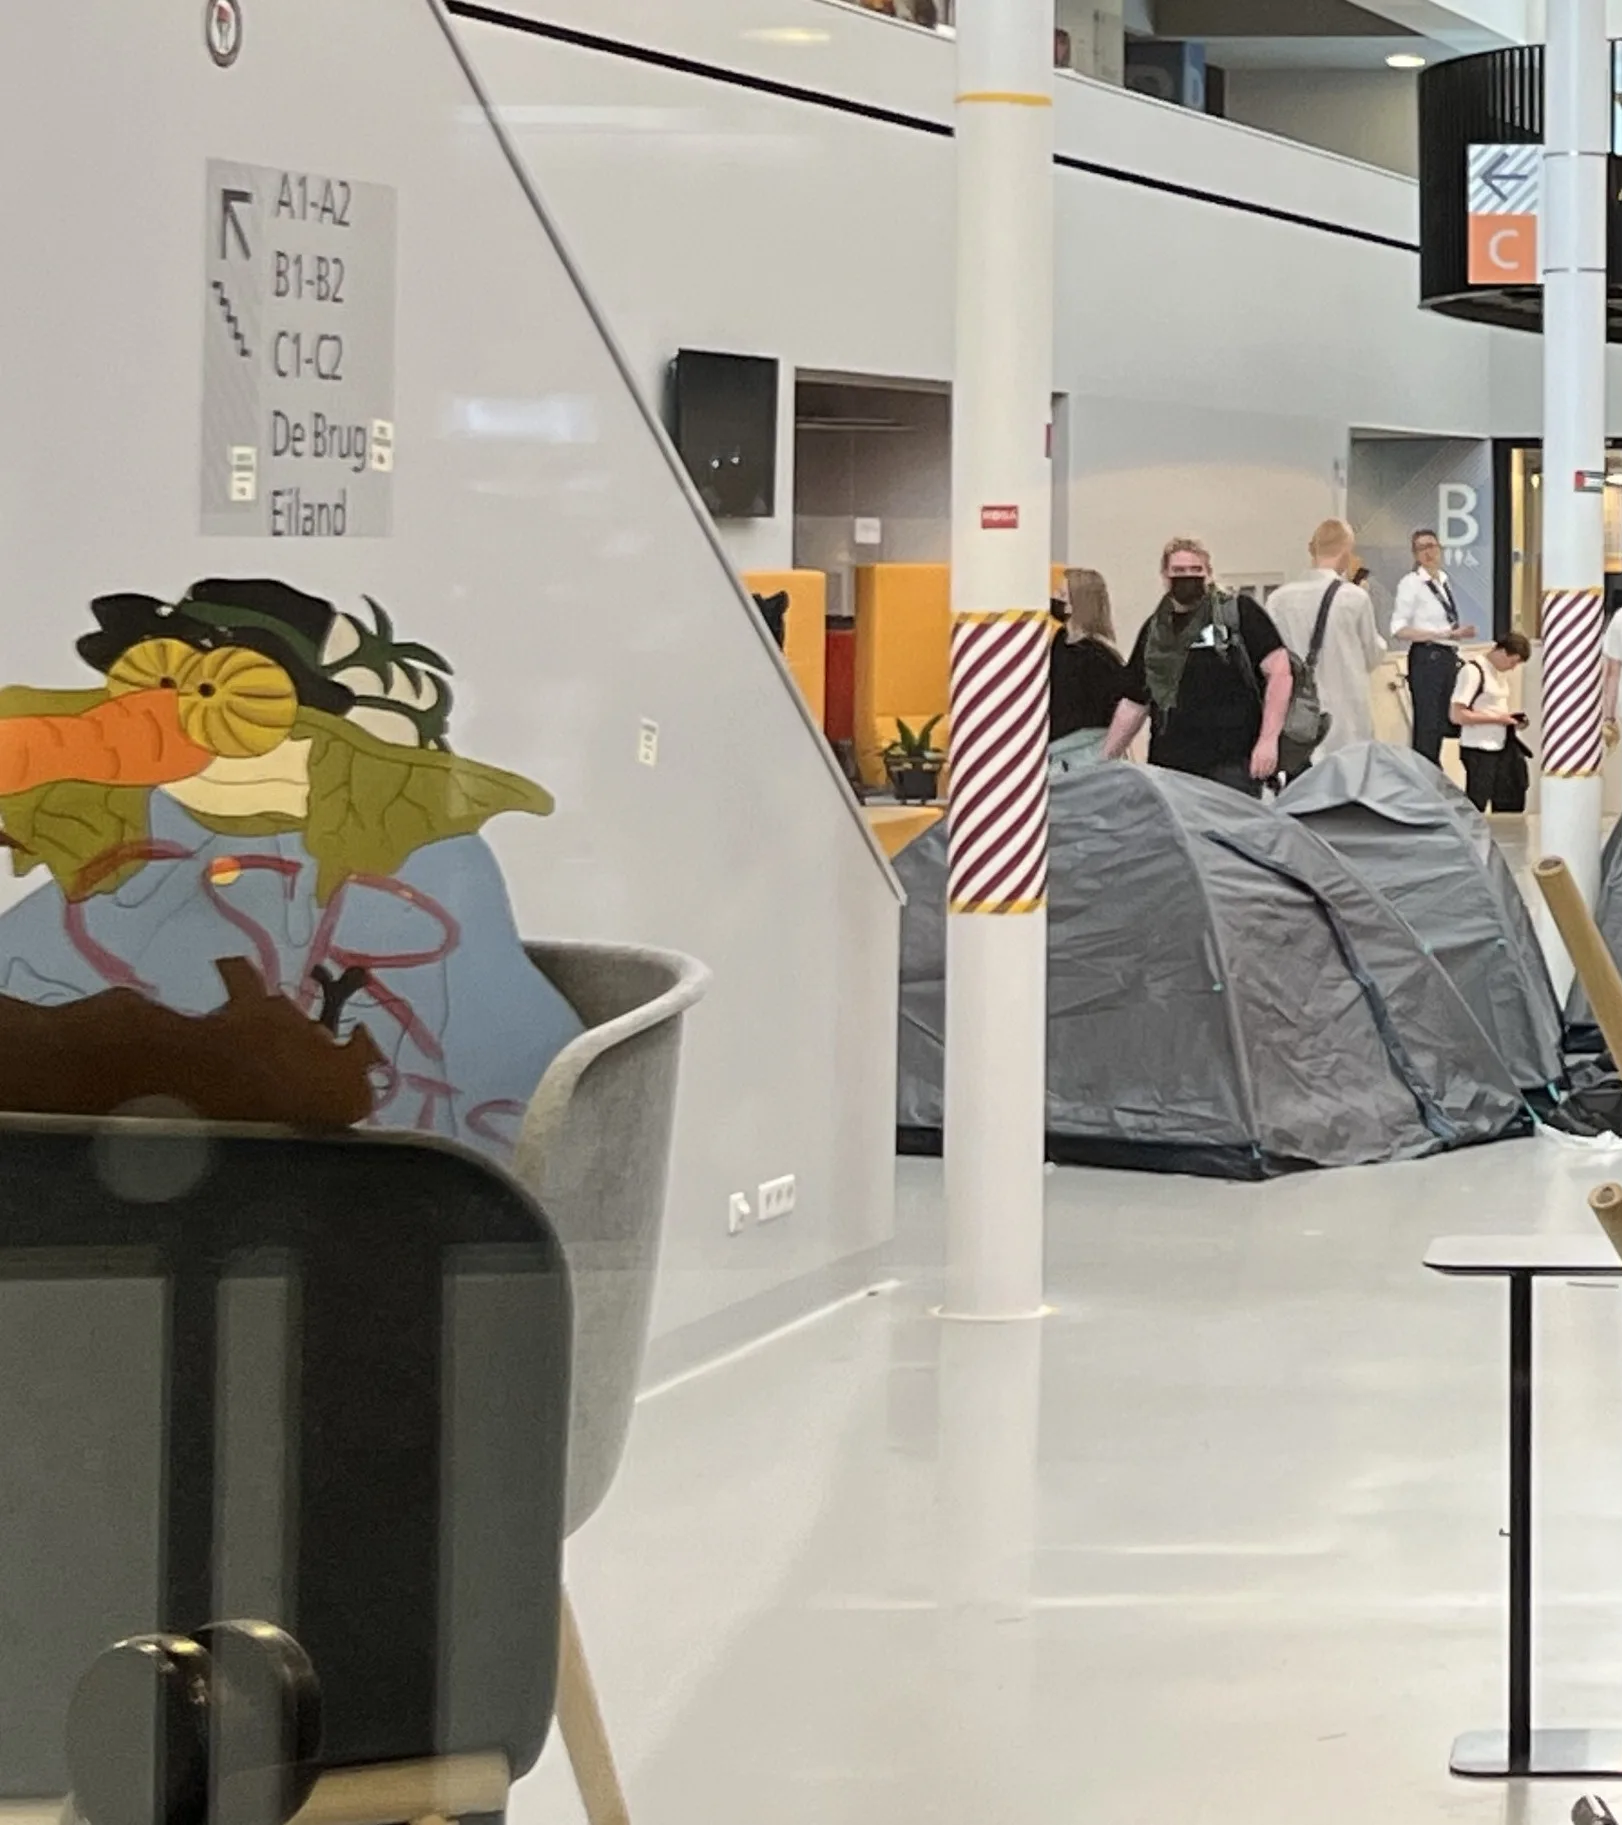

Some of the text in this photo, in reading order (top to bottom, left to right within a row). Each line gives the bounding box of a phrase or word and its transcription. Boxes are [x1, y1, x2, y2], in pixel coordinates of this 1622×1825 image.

[274, 172, 351, 227] A1-A2
[1488, 228, 1520, 271] C
[274, 250, 345, 304] B1-B2
[273, 330, 344, 382] C1-C2
[272, 408, 305, 458] De
[312, 411, 368, 474] Brug
[271, 486, 347, 537] Eiland
[1438, 483, 1480, 548] B
